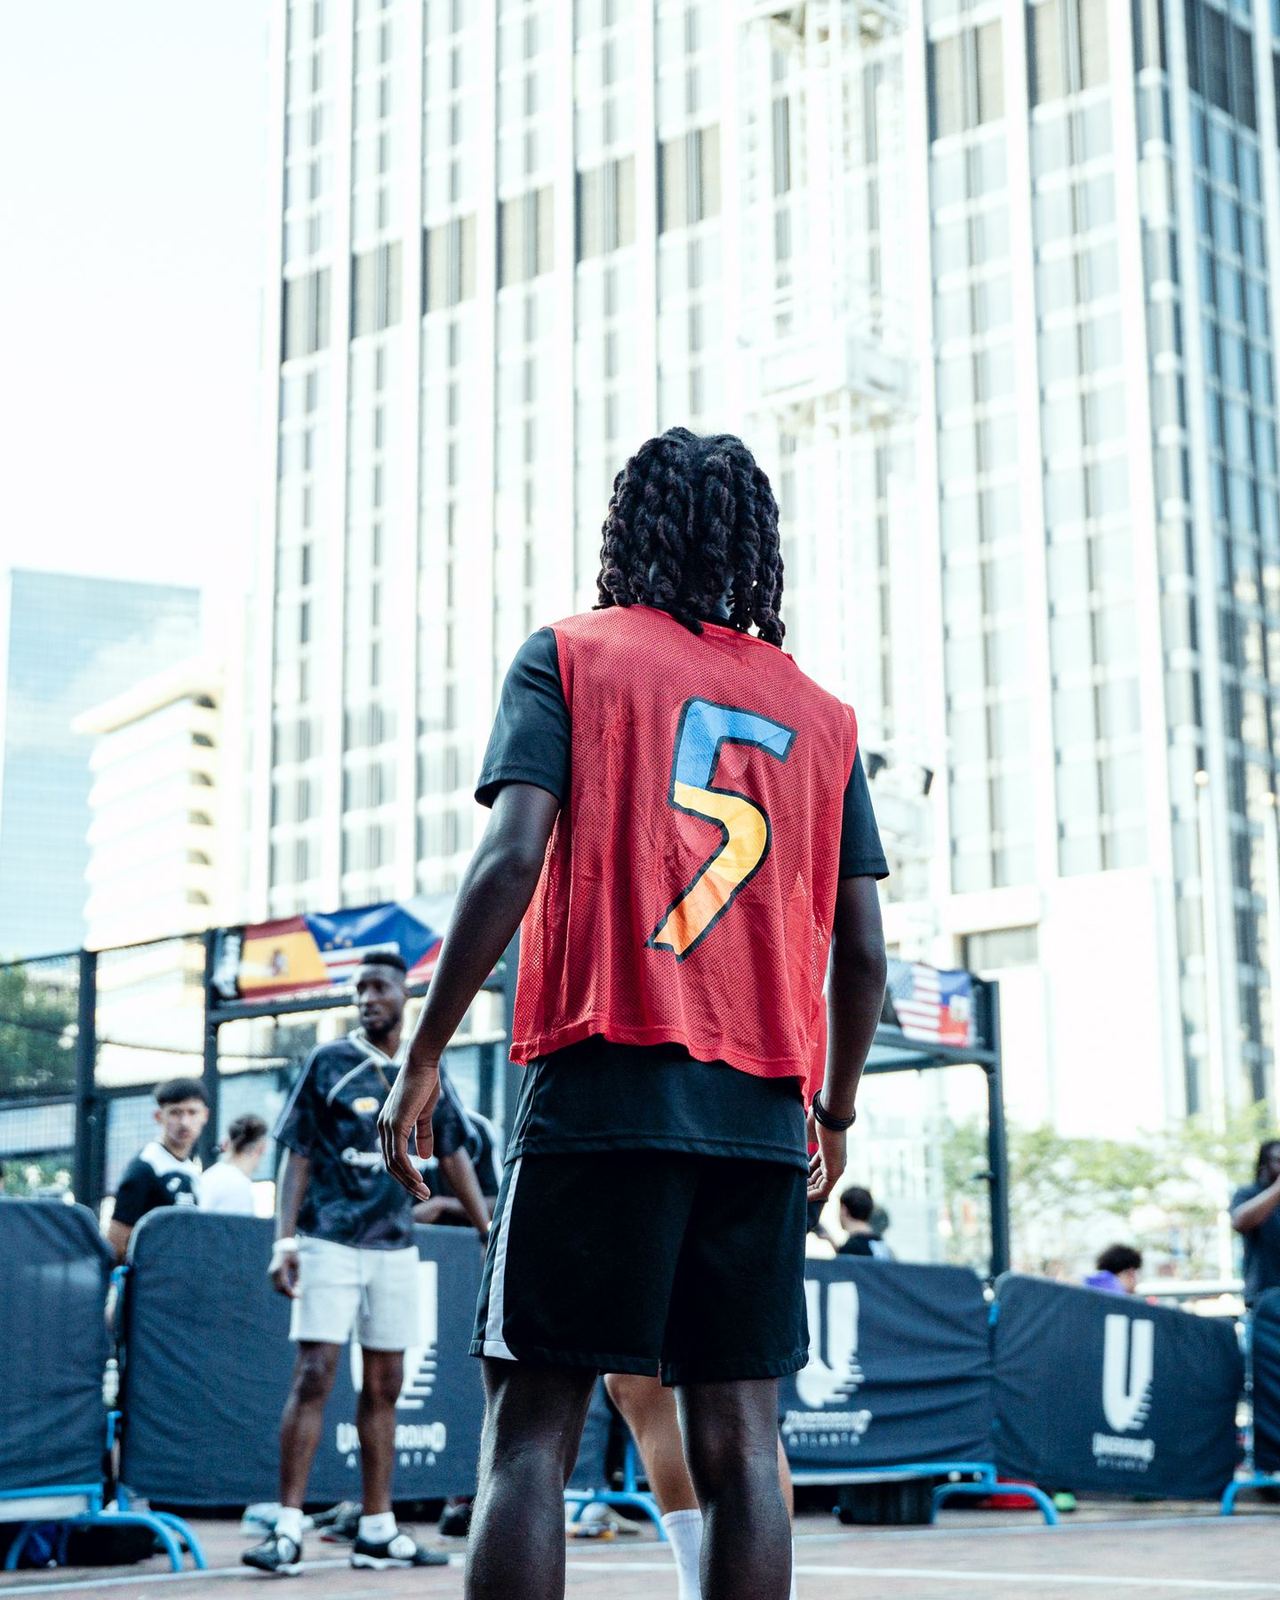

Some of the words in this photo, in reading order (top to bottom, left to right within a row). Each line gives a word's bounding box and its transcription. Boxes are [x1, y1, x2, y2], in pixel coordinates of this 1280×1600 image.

[644, 695, 798, 963] 5
[1102, 1314, 1154, 1432] U
[336, 1421, 447, 1453] UNROUND
